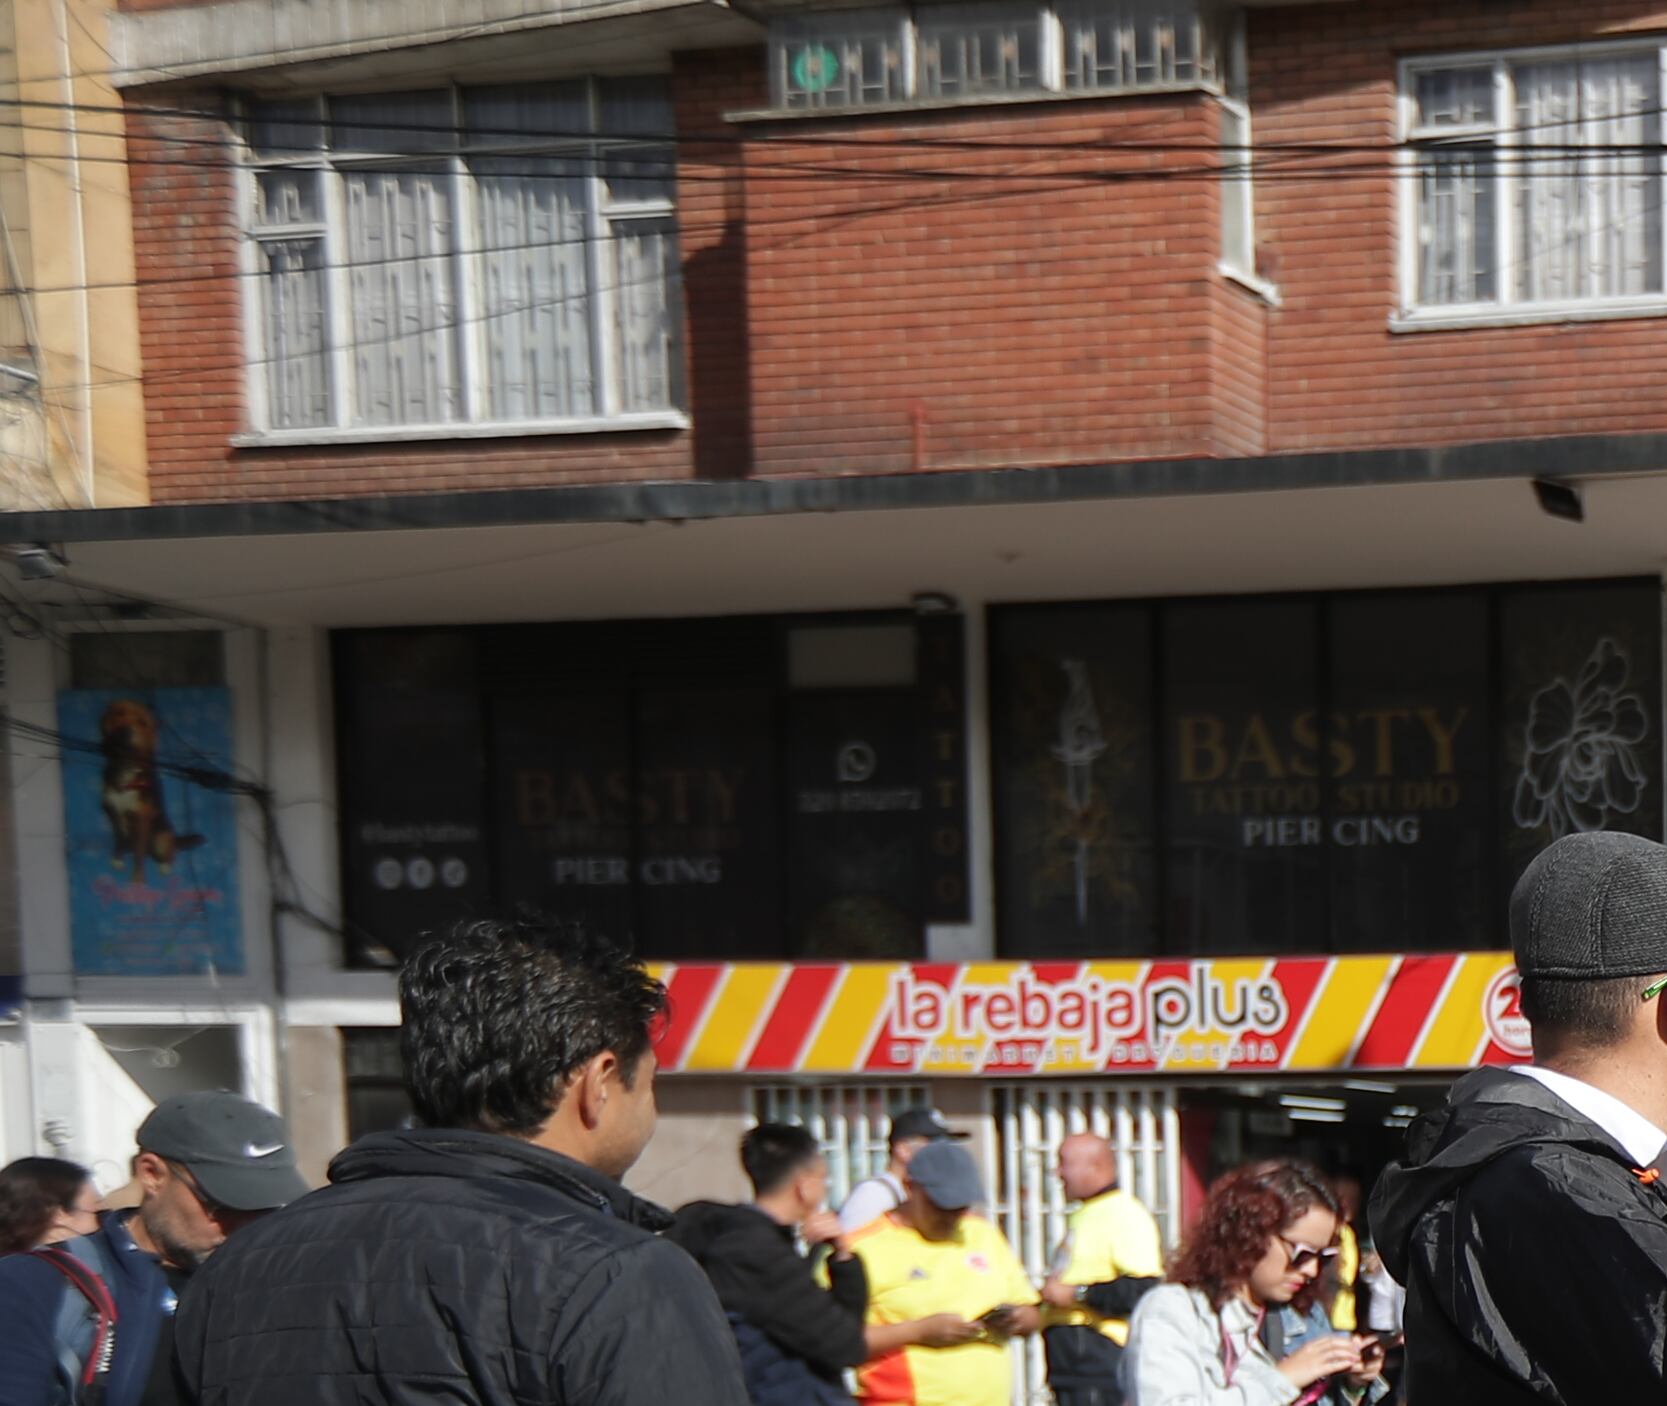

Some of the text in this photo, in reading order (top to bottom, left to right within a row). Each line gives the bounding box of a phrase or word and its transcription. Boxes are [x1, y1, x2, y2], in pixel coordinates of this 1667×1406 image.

[1176, 706, 1473, 784] BASTY
[515, 767, 745, 826] BASTY
[895, 967, 1283, 1053] la rebaja plus
